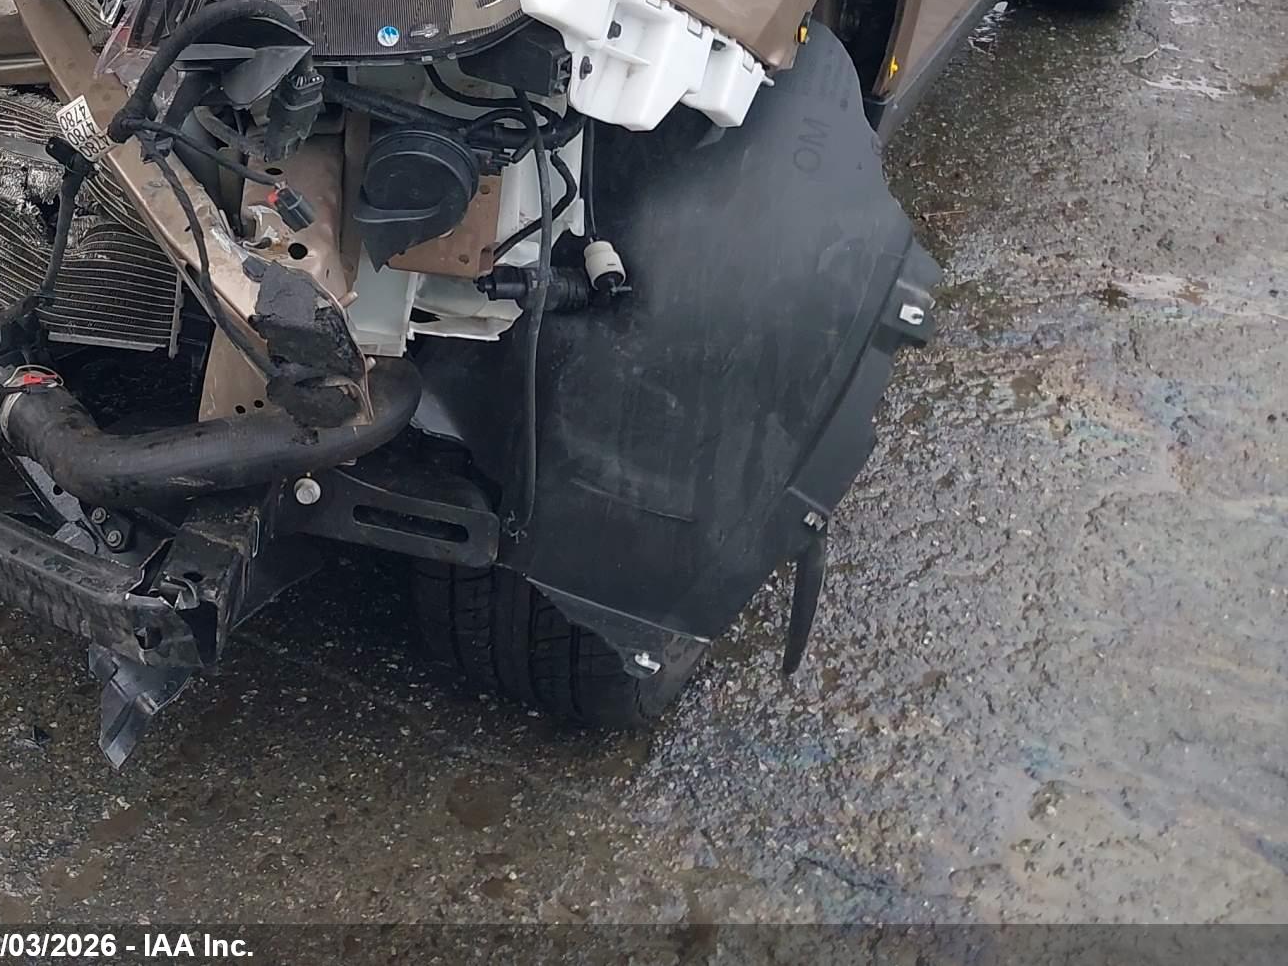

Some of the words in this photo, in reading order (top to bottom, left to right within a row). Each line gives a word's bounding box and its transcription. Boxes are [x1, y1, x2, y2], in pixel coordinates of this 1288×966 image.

[59, 103, 87, 132] 4780
[67, 121, 97, 146] 4780
[79, 135, 111, 158] 4780
